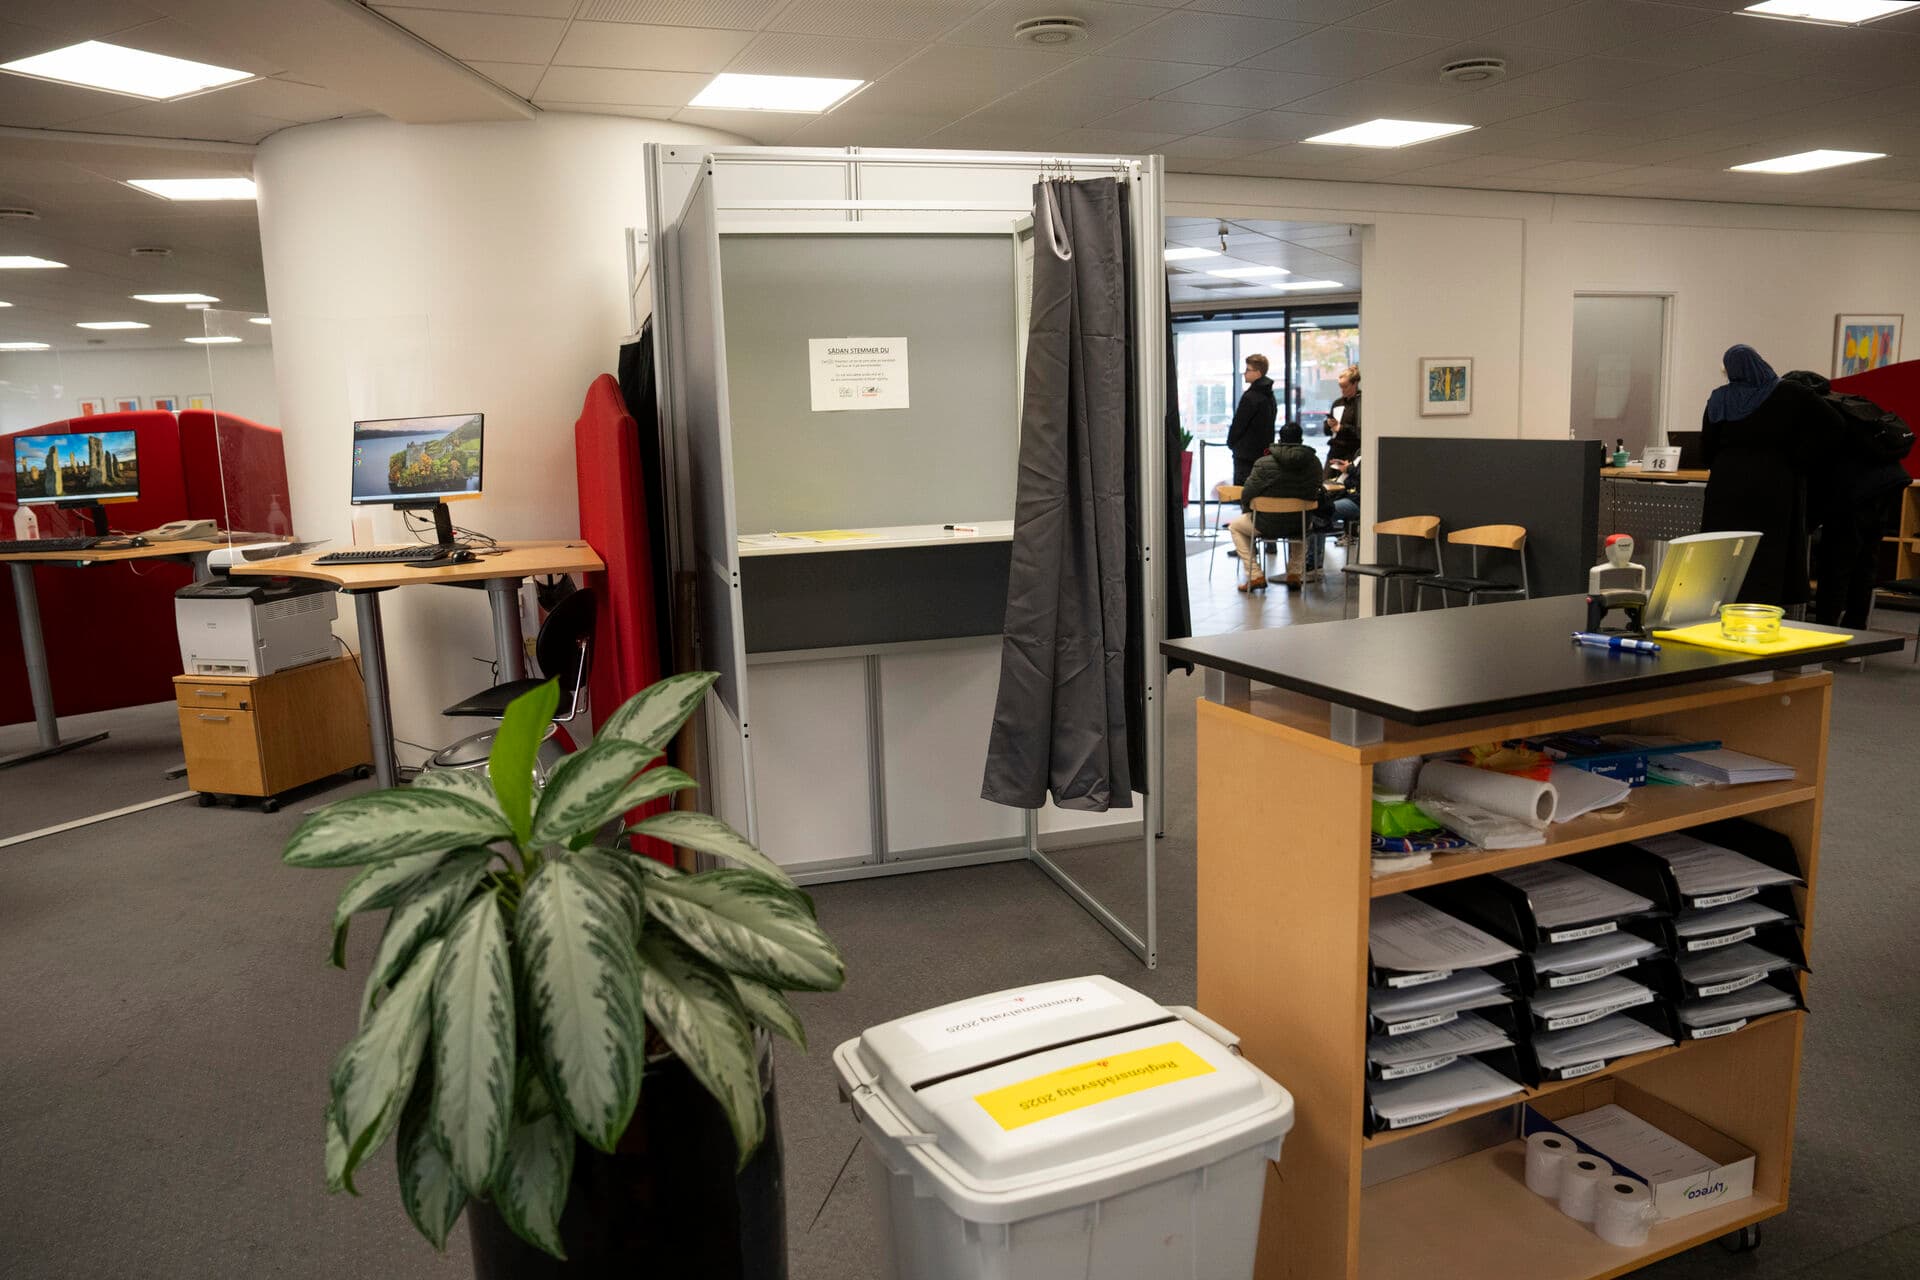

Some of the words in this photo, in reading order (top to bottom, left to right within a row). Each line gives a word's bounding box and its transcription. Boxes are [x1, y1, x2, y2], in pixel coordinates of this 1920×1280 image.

[828, 346, 849, 355] SÅDAN
[1651, 458, 1666, 469] 18
[980, 997, 1083, 1023] Kommunalvalg
[946, 1020, 979, 1033] 2025
[1057, 1061, 1178, 1097] Regionsrådsvalg
[1019, 1093, 1056, 1110] 2025
[1688, 1182, 1724, 1200] Lyreco
